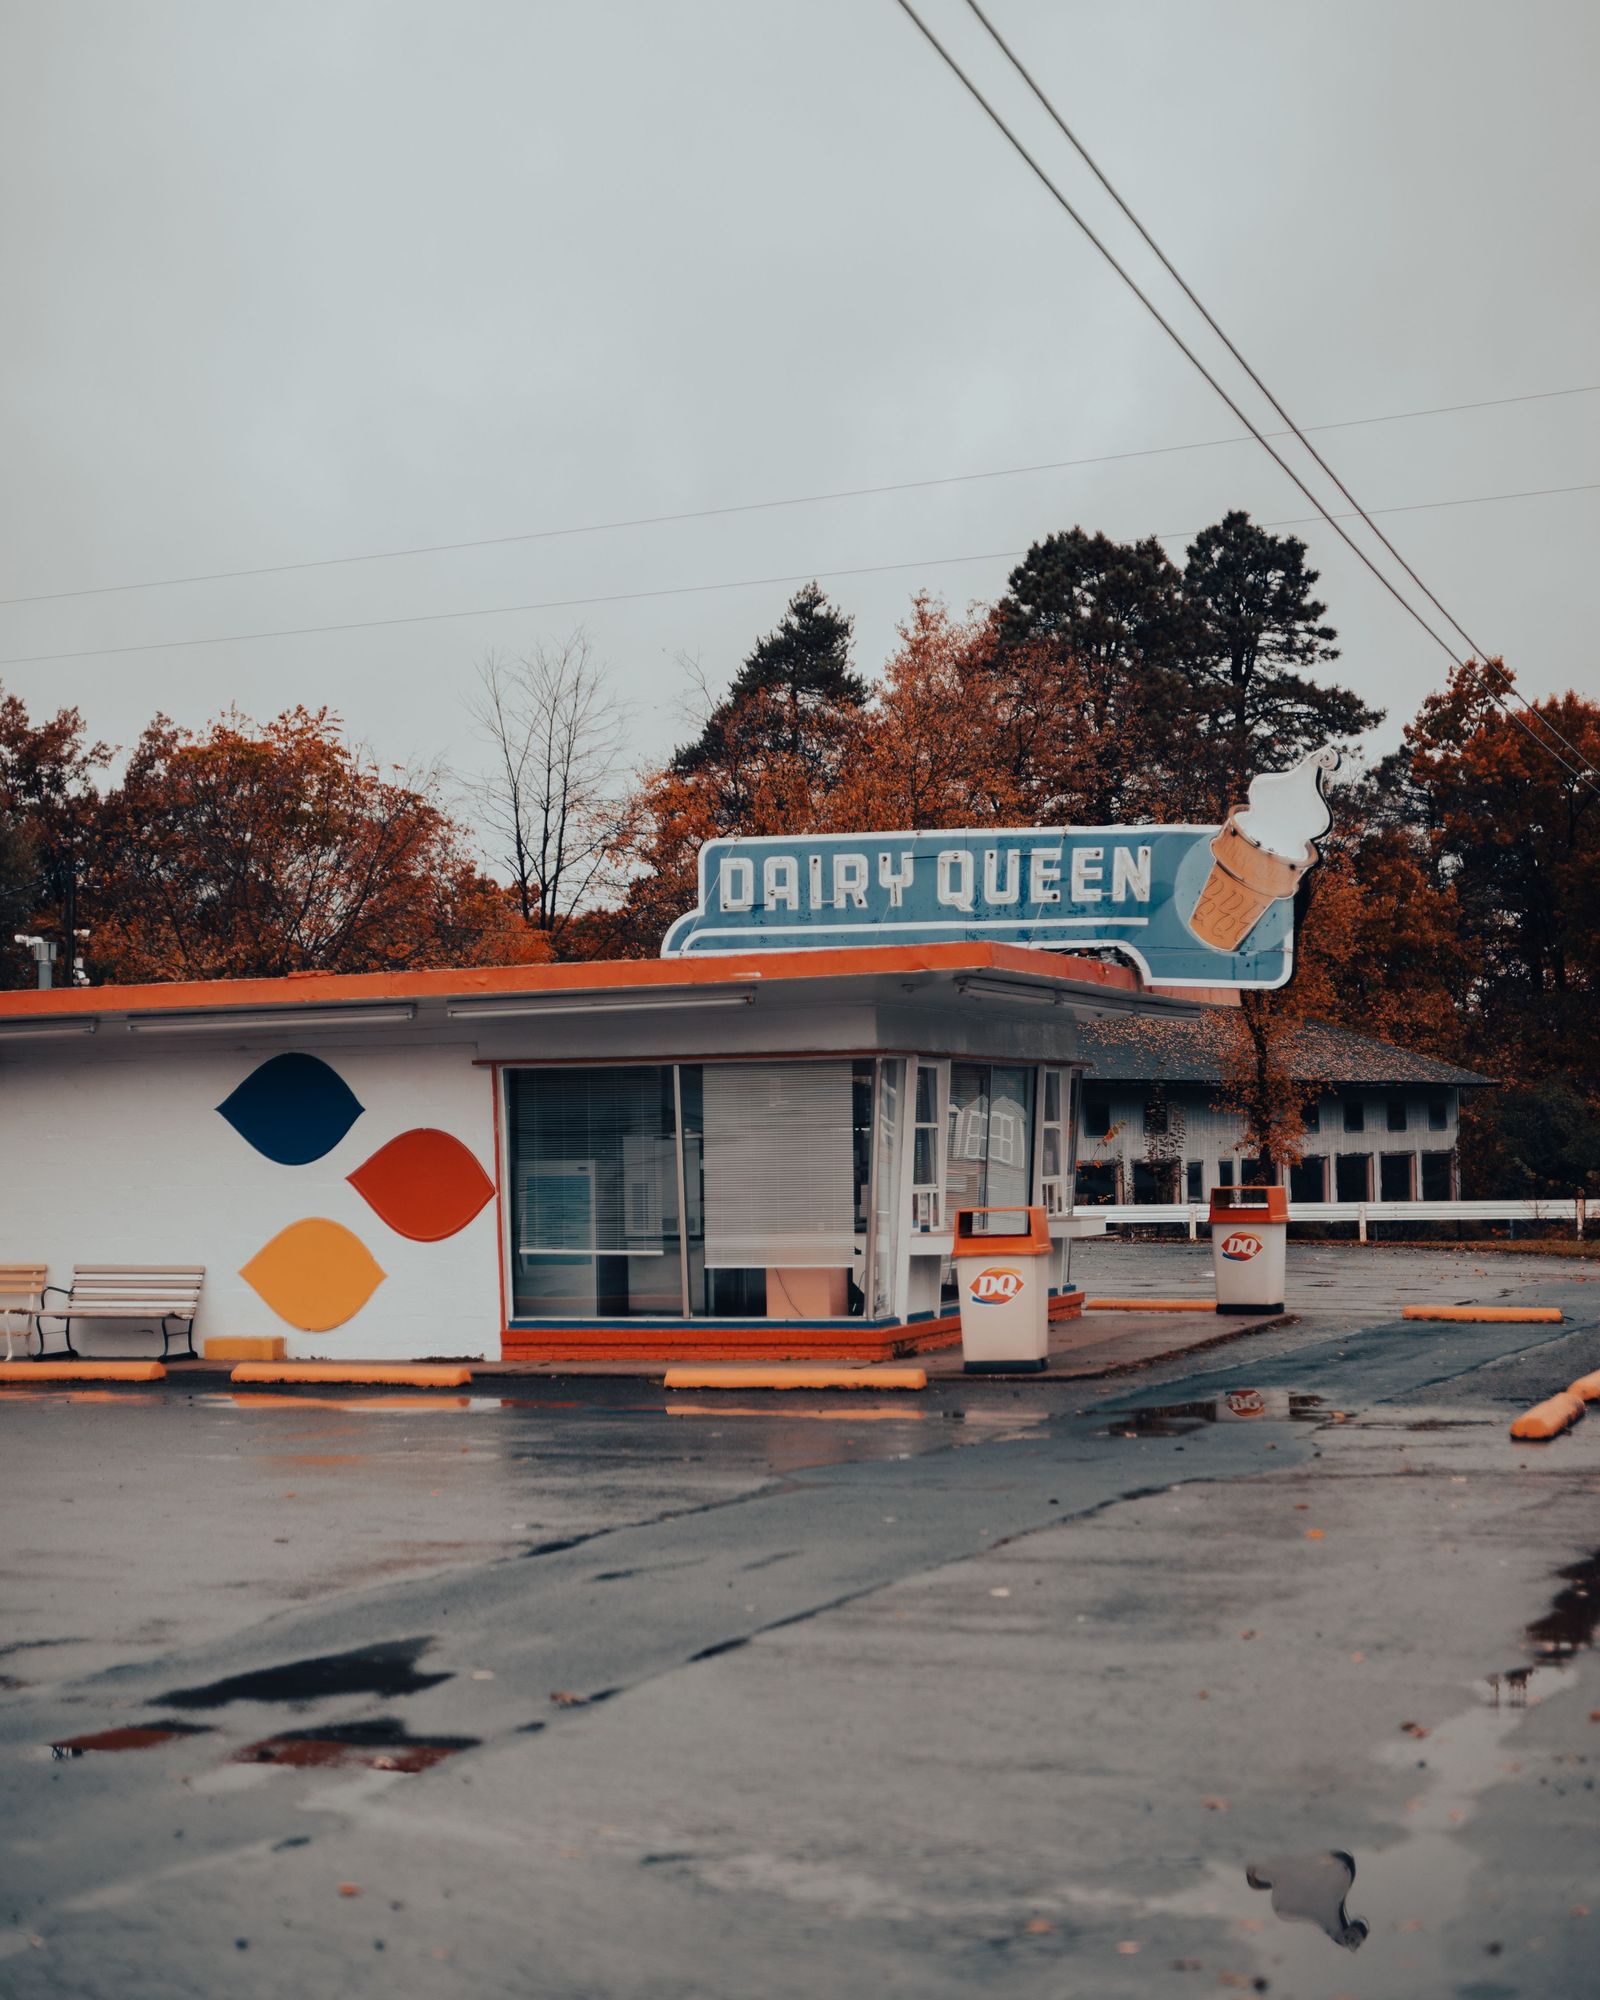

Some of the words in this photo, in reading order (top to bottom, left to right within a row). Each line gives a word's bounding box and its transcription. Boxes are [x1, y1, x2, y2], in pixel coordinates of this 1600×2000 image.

[719, 851, 914, 912] DAIRY
[937, 846, 1152, 912] QUEEN
[1227, 1238, 1257, 1256] DQ
[978, 1275, 1017, 1297] DQ
